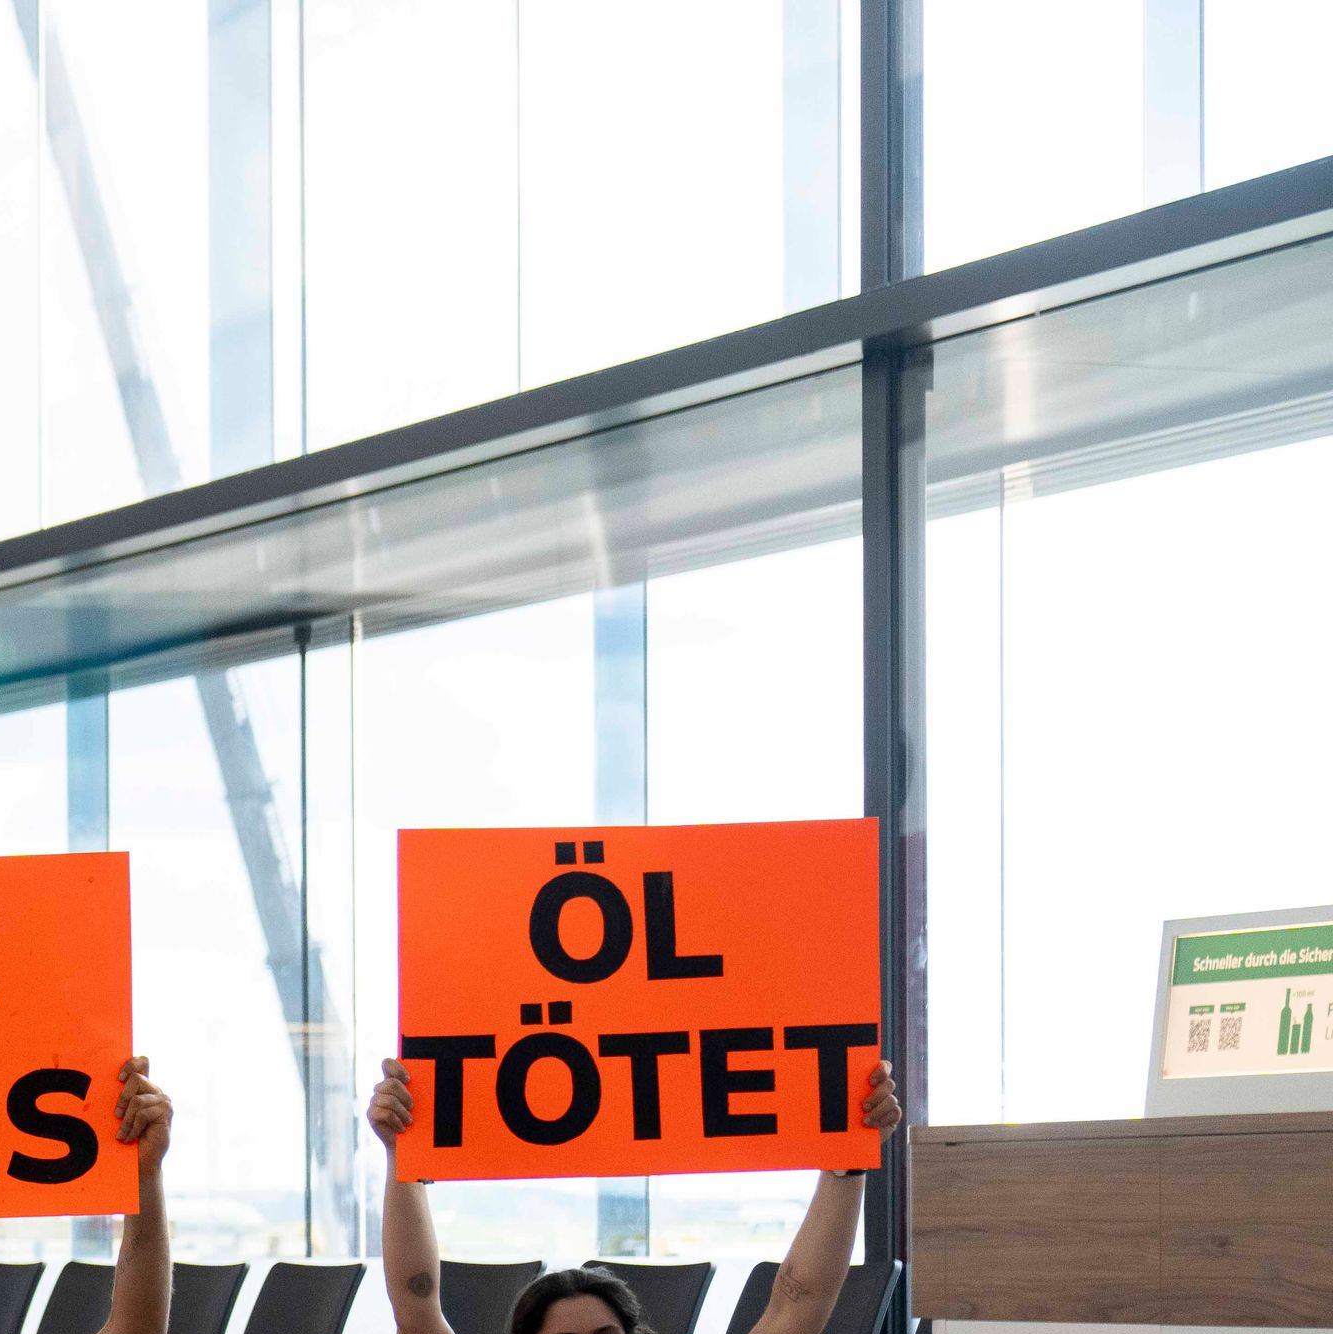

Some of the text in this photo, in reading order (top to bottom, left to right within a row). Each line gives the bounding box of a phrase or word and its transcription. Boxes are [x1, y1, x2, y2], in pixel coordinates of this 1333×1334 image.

[529, 841, 724, 984] ÖL
[1193, 954, 1244, 972] Schneller
[1245, 950, 1277, 967] durch
[1279, 948, 1298, 965] die
[402, 1001, 878, 1148] TÖTET
